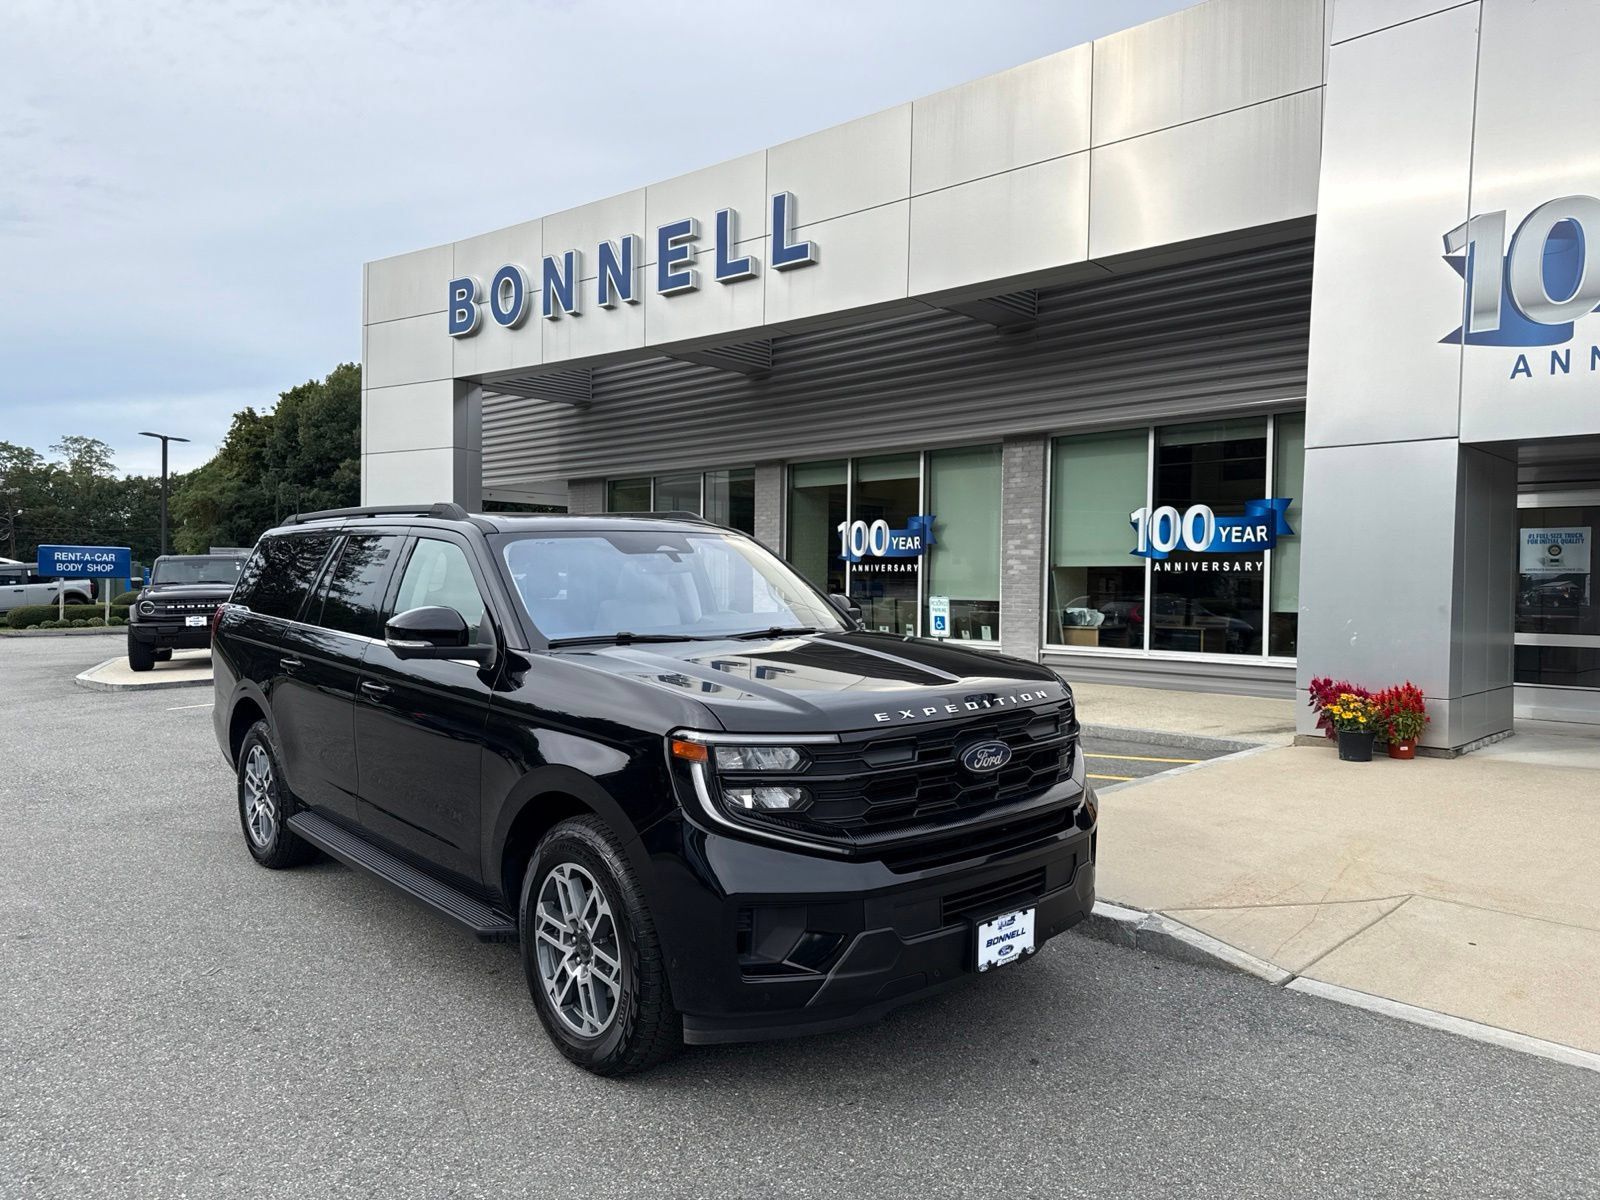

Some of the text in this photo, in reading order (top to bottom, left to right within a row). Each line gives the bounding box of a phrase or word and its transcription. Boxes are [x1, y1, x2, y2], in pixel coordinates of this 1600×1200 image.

[449, 191, 817, 338] BONNELL
[837, 519, 921, 557] 100 YEAR
[1130, 504, 1268, 552] 100 YEAR
[54, 552, 116, 562] RENT-A-CAR
[56, 563, 114, 572] BODY SHOP
[852, 563, 919, 572] ANNIVERSARY
[1154, 561, 1263, 572] ANNIVERSARY
[874, 690, 1048, 722] EXPEDITION
[974, 747, 1003, 769] Ford
[986, 927, 1026, 948] BONNELL
